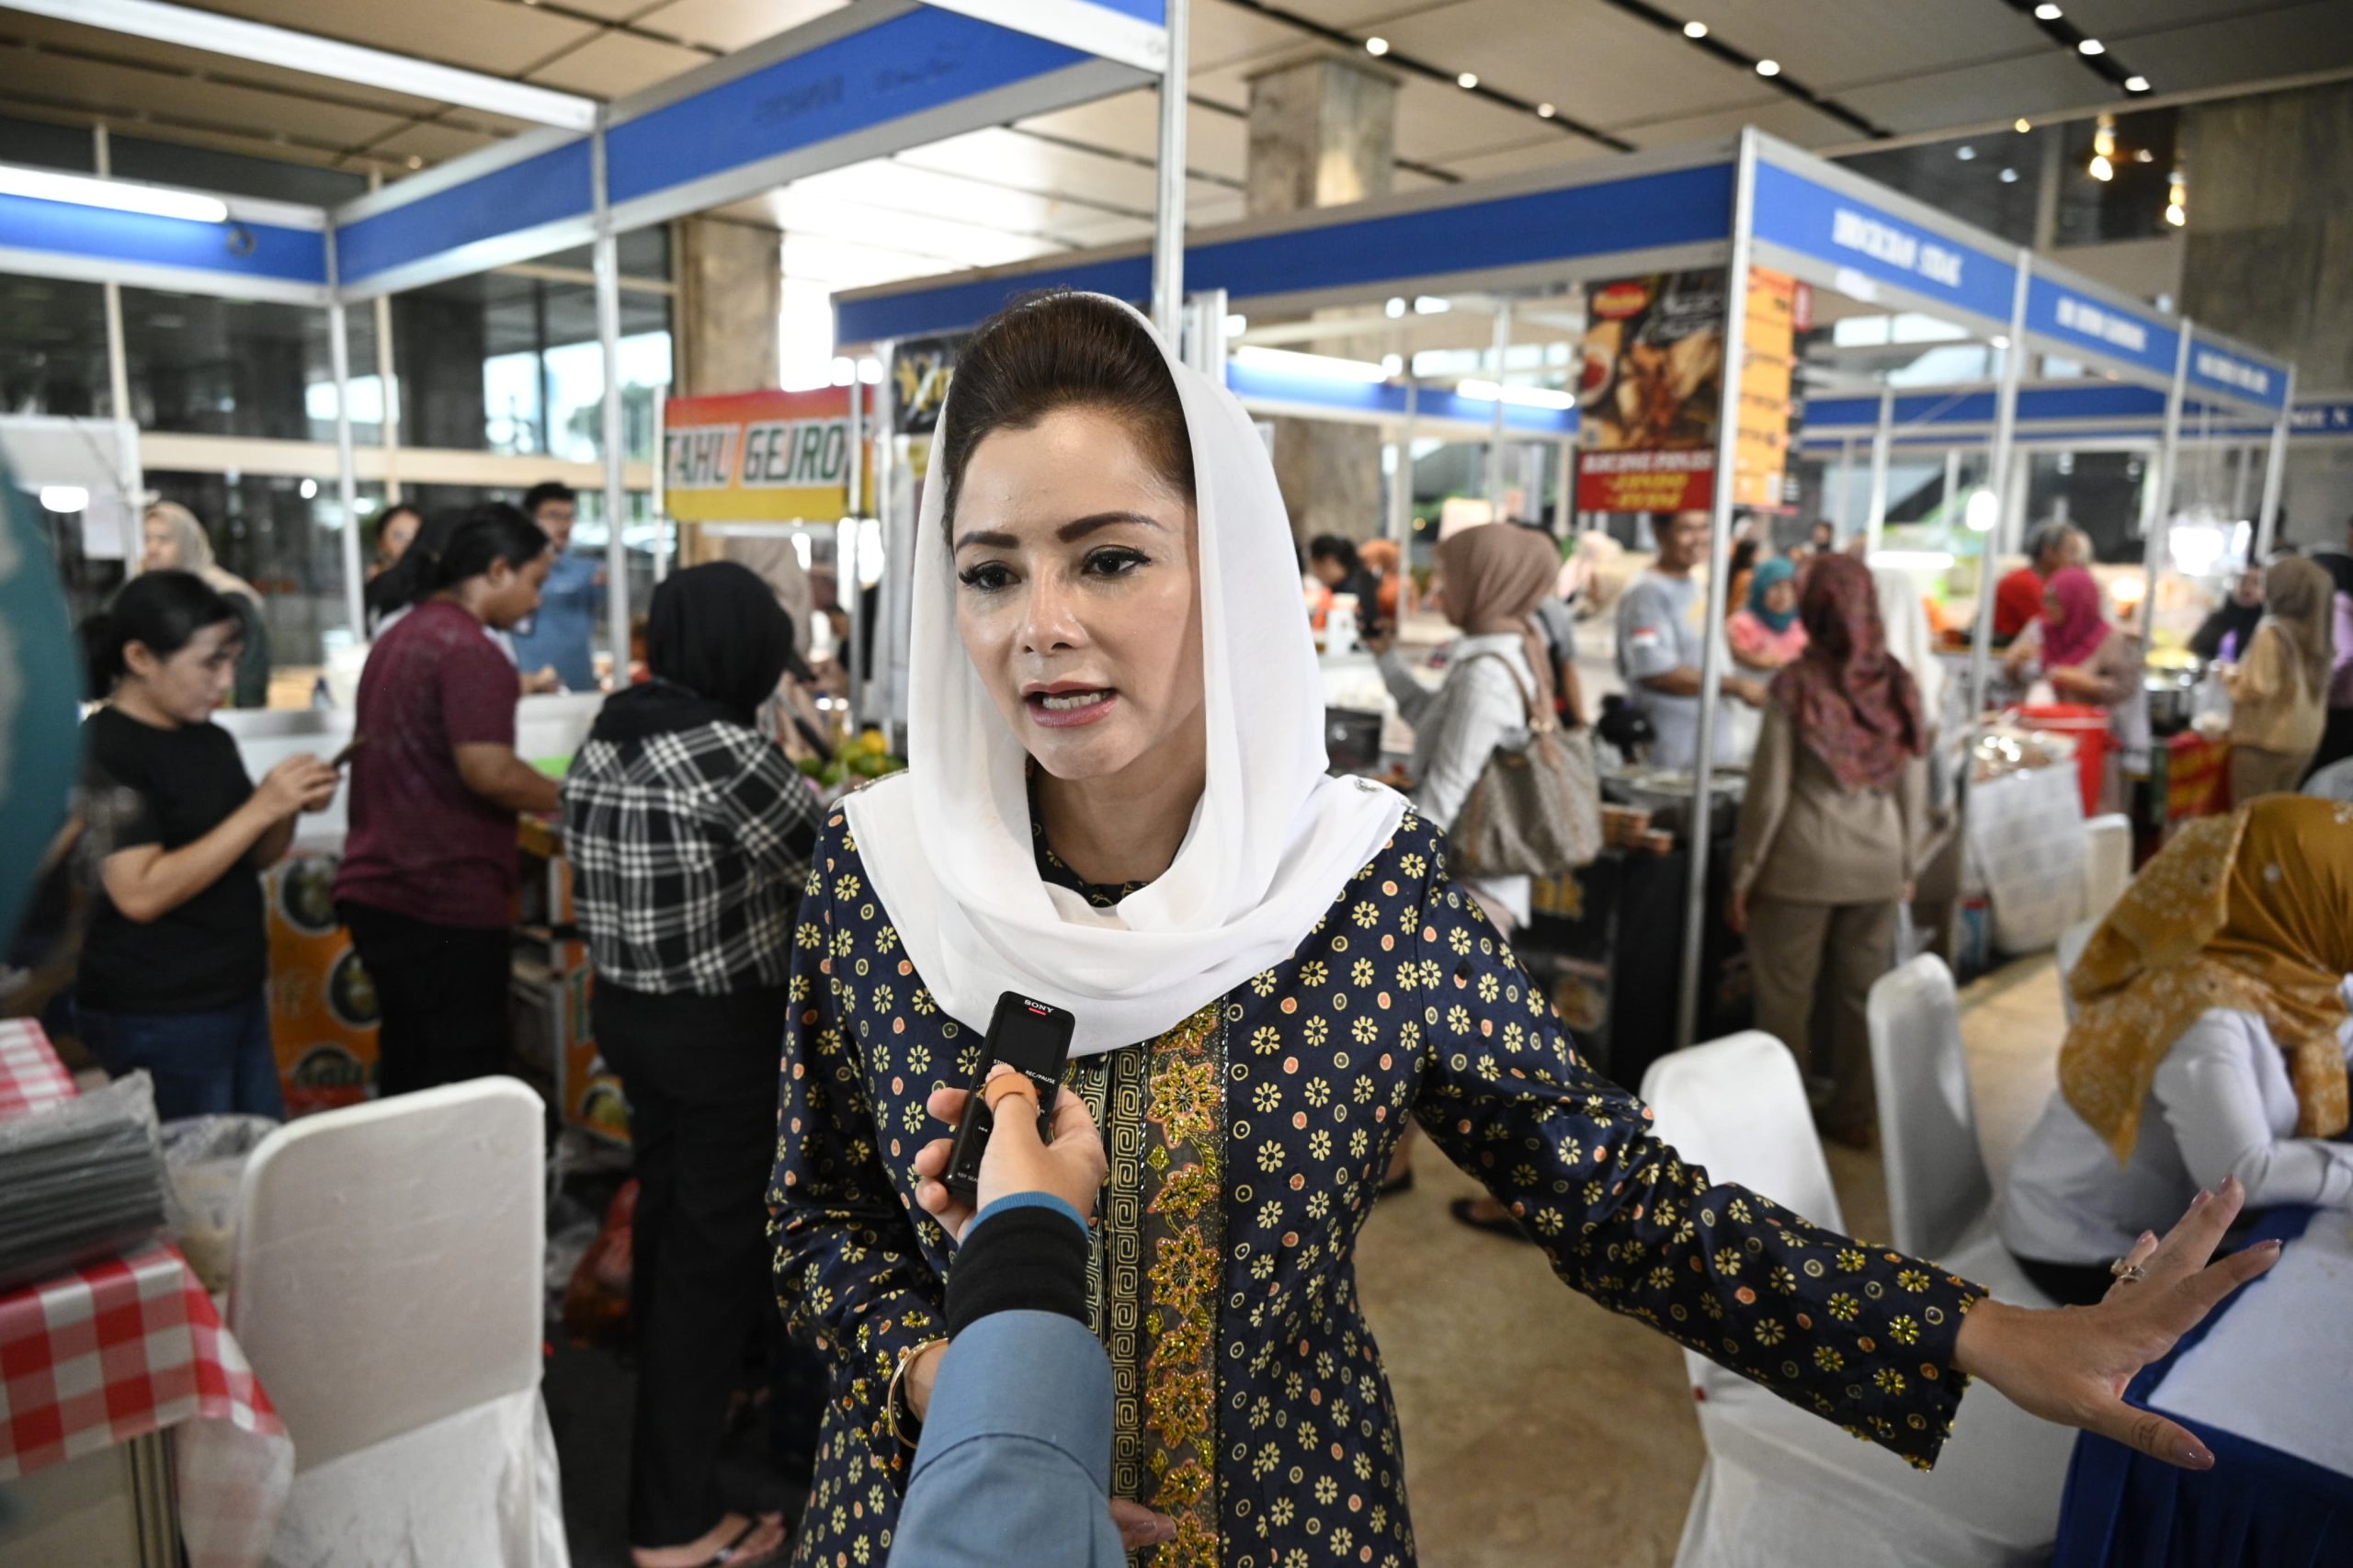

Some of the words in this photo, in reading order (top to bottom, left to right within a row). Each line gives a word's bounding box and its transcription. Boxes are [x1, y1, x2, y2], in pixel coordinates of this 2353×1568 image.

[743, 422, 869, 483] GEJRO
[1024, 999, 1054, 1013] SONY
[1025, 1070, 1055, 1085] REC/PAUSE
